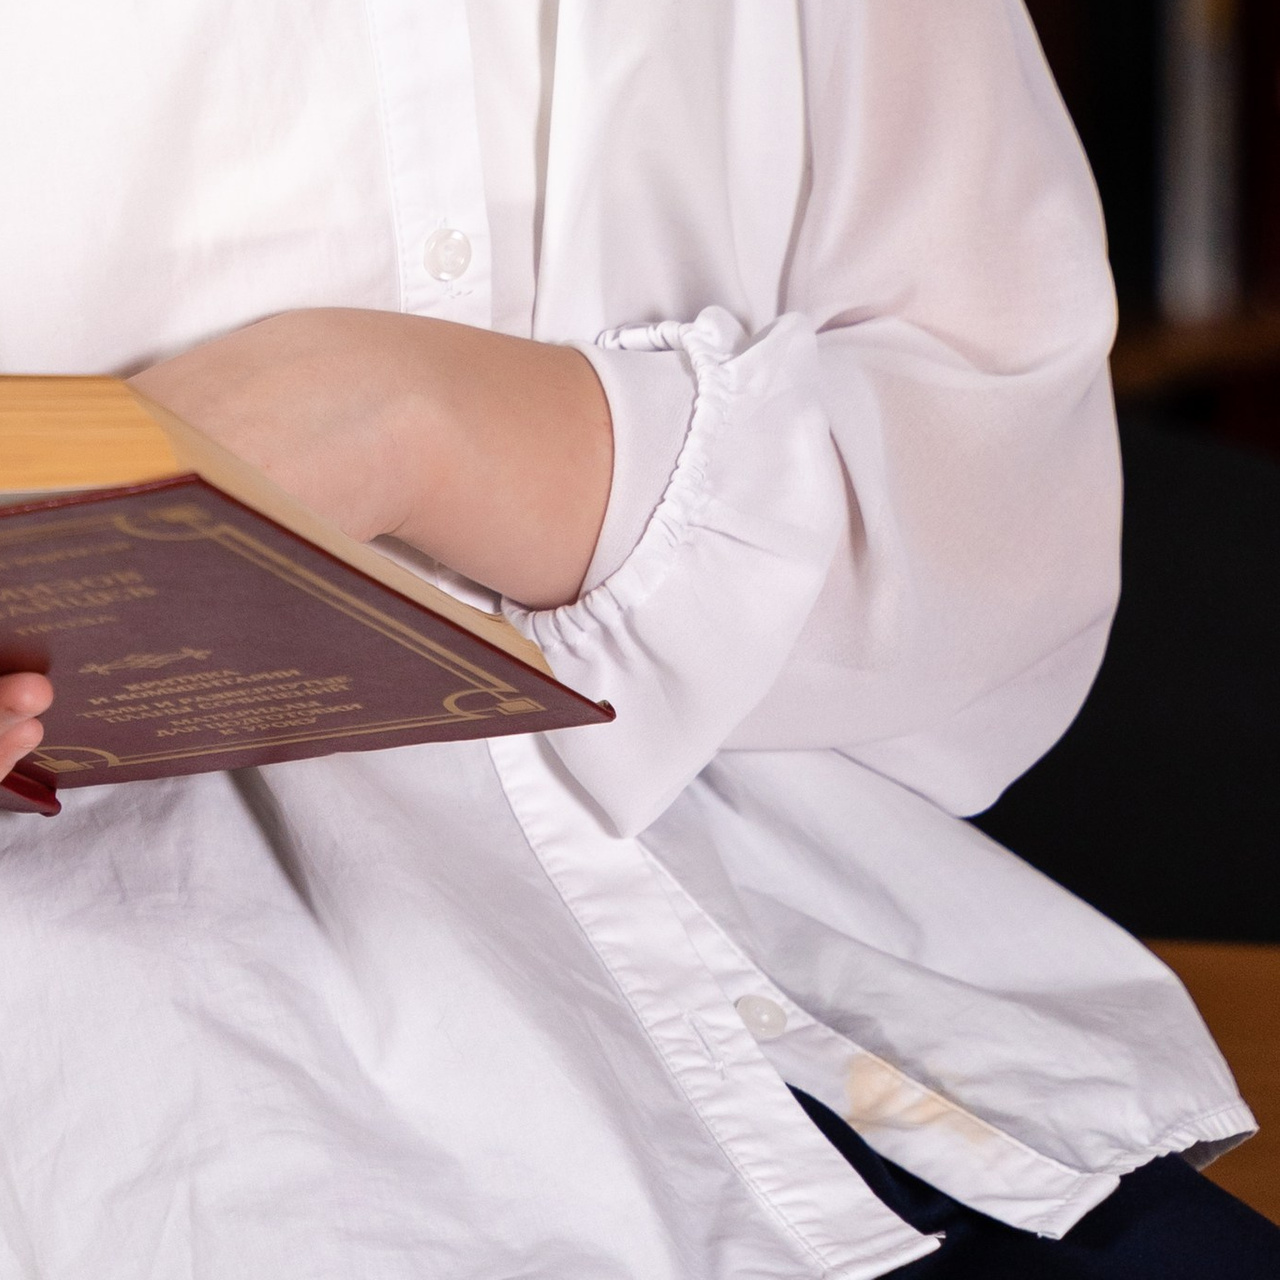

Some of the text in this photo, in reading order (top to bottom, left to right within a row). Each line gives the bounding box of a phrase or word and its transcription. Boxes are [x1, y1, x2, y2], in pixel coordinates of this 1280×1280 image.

[86, 668, 303, 705] И КОММЕНТАРИИ
[121, 668, 240, 692] КРИТИКА
[76, 704, 151, 719] ТЕМЫ
[152, 700, 175, 708] И
[103, 682, 352, 723] ПЛАНЫ СОЧИНЕНИЙ
[168, 699, 322, 727] МАТЕРИАЛЫ
[152, 702, 366, 737] ДЛЯ ПОДГОТОВКИ
[217, 716, 322, 736] К УРОКУ
